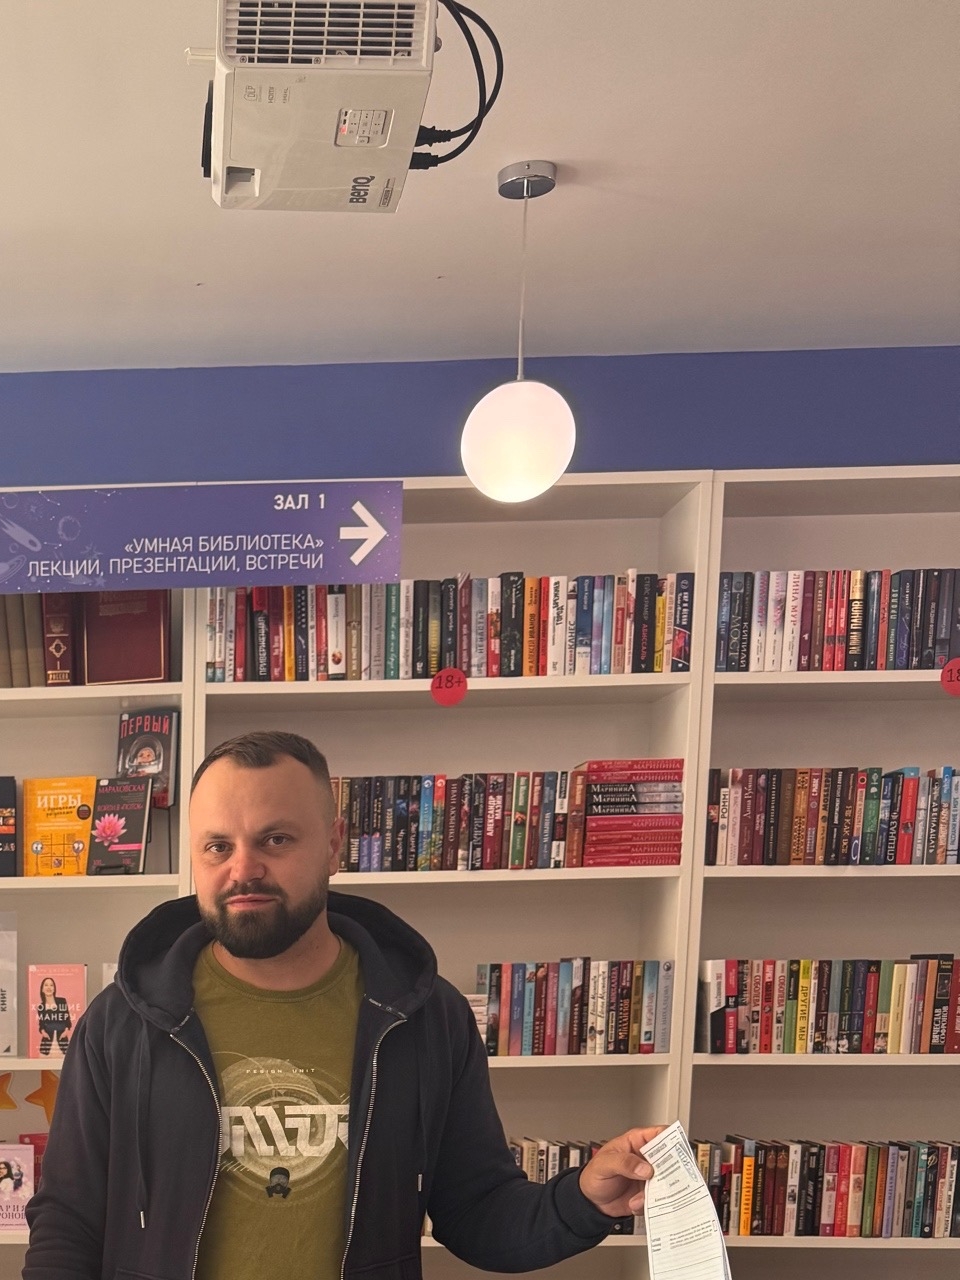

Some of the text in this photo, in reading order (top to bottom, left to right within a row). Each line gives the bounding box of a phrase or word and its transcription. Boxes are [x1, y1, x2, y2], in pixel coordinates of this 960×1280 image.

[349, 175, 375, 204] BenQ
[274, 494, 325, 510] ЗАЛ 1
[124, 534, 323, 553] «УМНАЯ БИБЛИОТЕКА»
[27, 553, 324, 578] ЛЕКЦИИ, ПРЕЗЕНТАЦИИ, ВСТРЕЧИ
[791, 573, 799, 602] ЛИНА
[729, 615, 741, 658] МОСТ
[434, 675, 464, 689] 18+
[120, 715, 170, 738] ПЕРВЫЙ
[37, 794, 82, 808] ИГРЫ
[487, 795, 495, 836] АЛЕКСАНДР
[887, 821, 897, 861] СПЕЦНАЗ
[929, 802, 938, 853] ДВЕНАДЦАТЬ
[777, 975, 785, 1008] СОБОЛЕВА
[31, 1003, 81, 1012] ХОРОШИЕ
[35, 1013, 77, 1021] МАНЕРЫ
[798, 985, 808, 1041] ДРУГИЕ МЫ
[932, 1008, 941, 1043] ВЯЧЕСЛАВ
